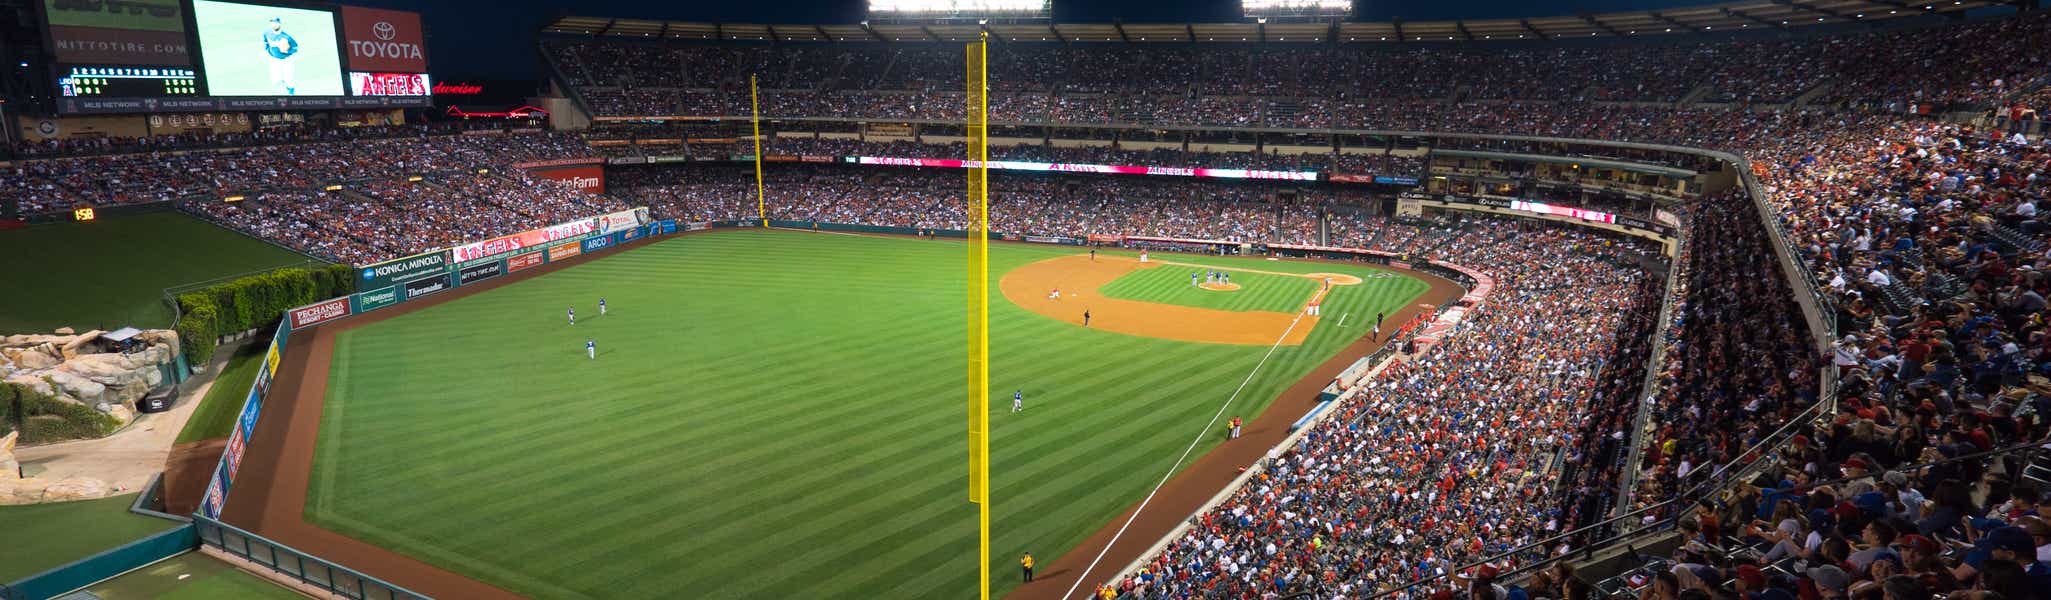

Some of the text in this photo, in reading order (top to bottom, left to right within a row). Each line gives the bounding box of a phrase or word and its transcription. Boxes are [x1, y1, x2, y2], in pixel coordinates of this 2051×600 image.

[350, 40, 423, 60] TOYOTA
[361, 74, 427, 95] ANGELS
[75, 208, 95, 220] 1:58
[588, 238, 606, 249] ARCO
[375, 255, 442, 277] KONICA MINOLTA
[368, 290, 394, 303] National
[408, 282, 443, 297] Thermador
[297, 302, 344, 320] PECHANGA
